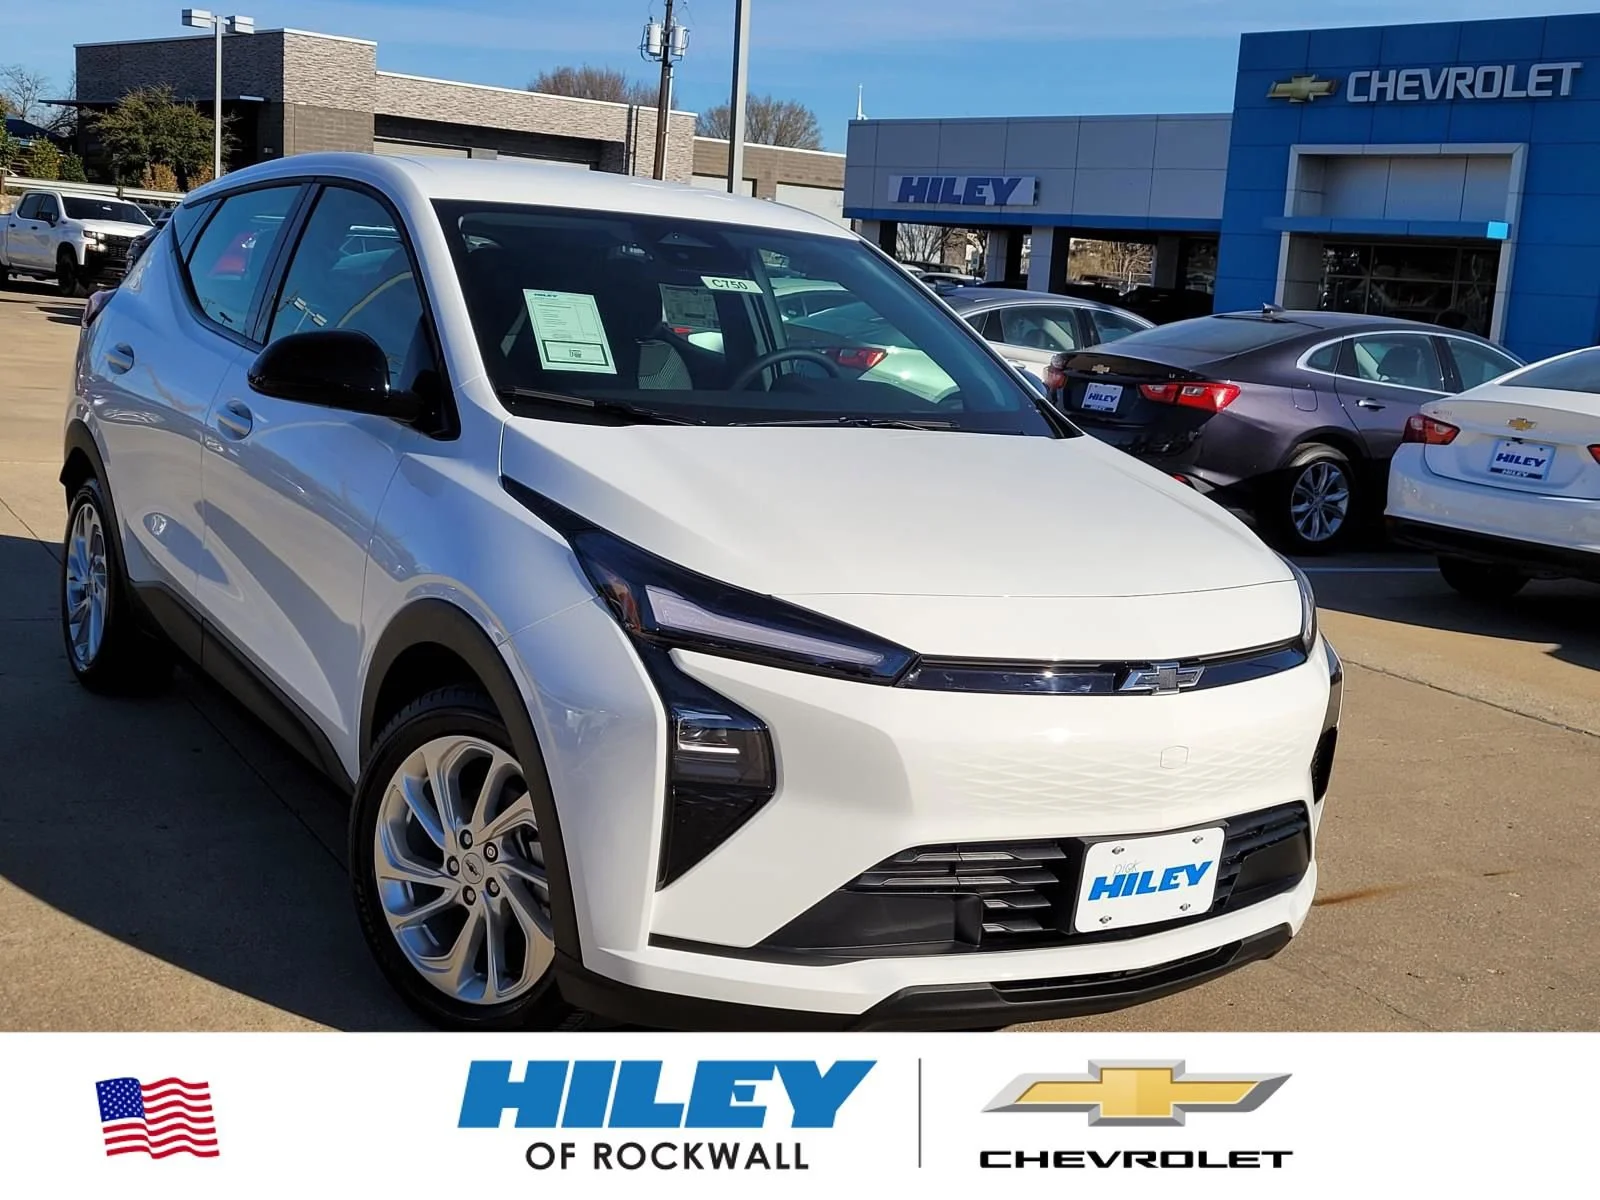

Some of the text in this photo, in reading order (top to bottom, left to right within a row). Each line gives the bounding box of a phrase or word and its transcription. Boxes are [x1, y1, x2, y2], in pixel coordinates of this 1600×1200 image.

[1346, 62, 1584, 102] CHEVROLET
[898, 177, 1022, 206] HILEY
[712, 279, 748, 290] C750
[1088, 393, 1118, 402] HILEY
[1496, 453, 1546, 467] HILEY
[1088, 861, 1213, 901] HILEY
